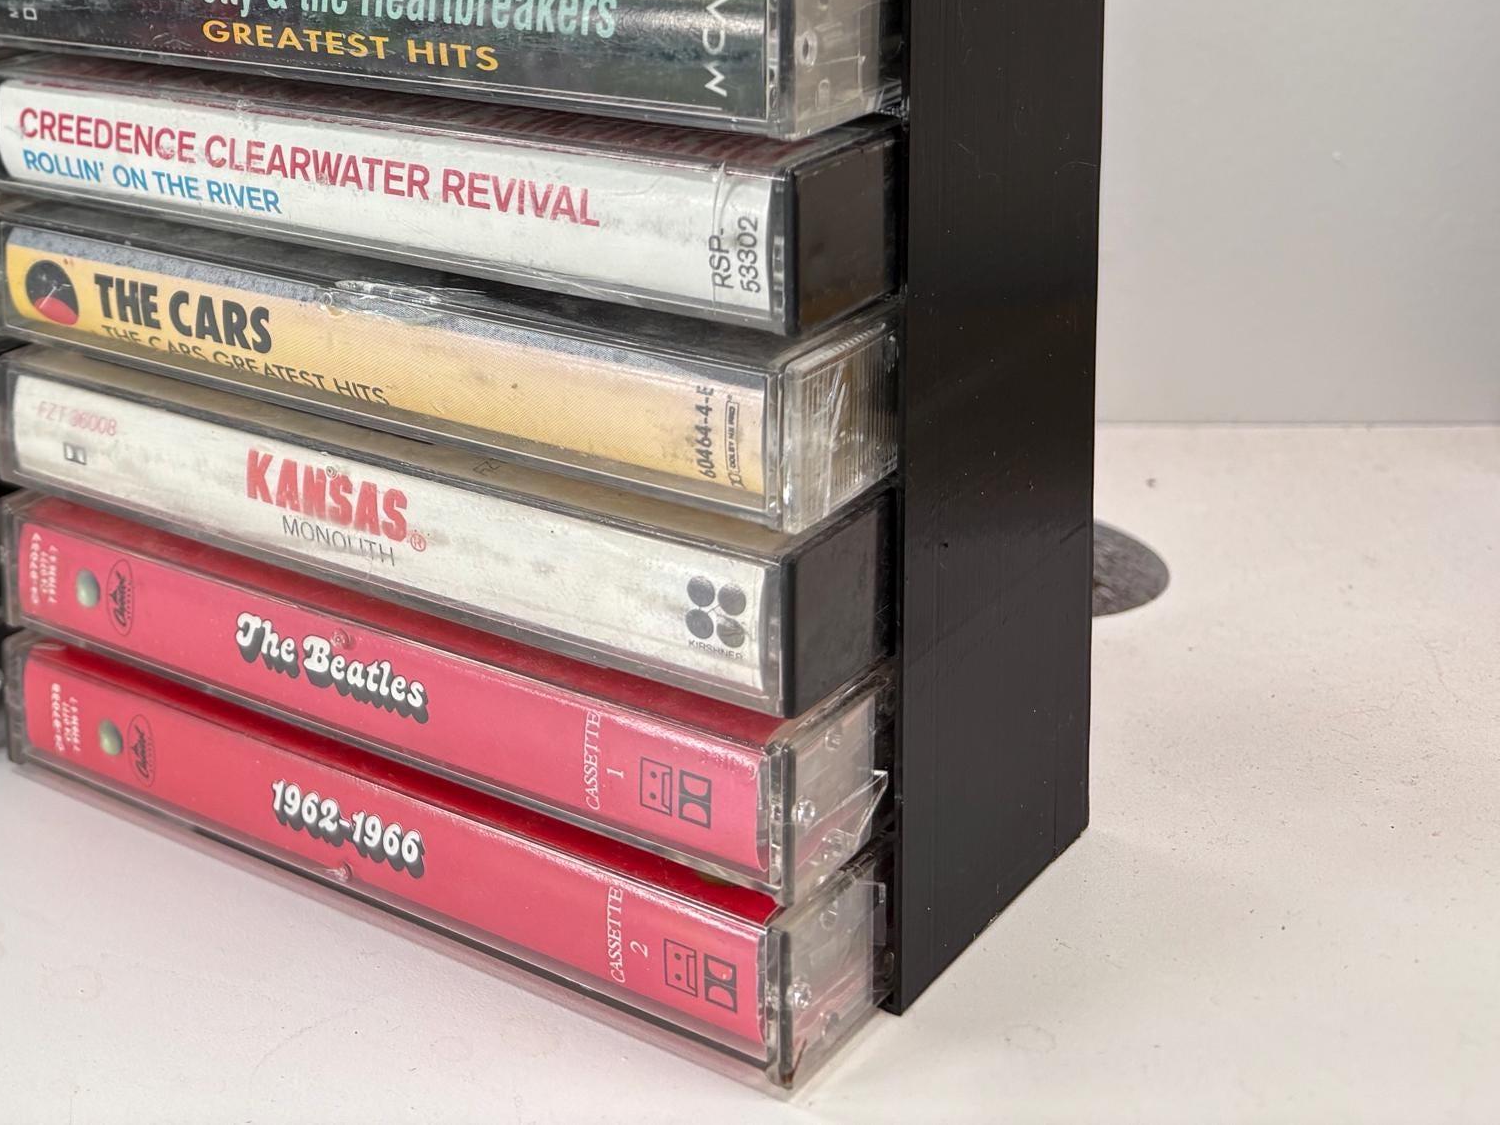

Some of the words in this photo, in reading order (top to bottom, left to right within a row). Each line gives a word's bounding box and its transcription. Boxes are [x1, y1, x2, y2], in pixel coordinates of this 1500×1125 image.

[202, 20, 388, 59] GREATEST
[408, 39, 498, 72] HITS
[20, 107, 196, 165] CREEDENCE
[204, 134, 431, 201] CLEARWATER
[442, 168, 600, 228] REVIVAL
[23, 148, 104, 184] ROLLIN'
[112, 164, 148, 192] ON
[152, 171, 199, 201] THE
[206, 179, 283, 215] RIVER
[737, 215, 760, 295] 53302
[94, 273, 162, 331] THE
[169, 290, 274, 354] CARS
[102, 324, 142, 345] THE
[148, 335, 210, 363] CARS
[213, 350, 328, 392] GREATEST
[332, 376, 390, 406] HITS
[694, 385, 717, 479] 60464-4-E
[245, 447, 408, 542] KANSAS
[282, 515, 396, 567] MONOLITH
[236, 611, 298, 671] The
[301, 633, 428, 715] Beatles
[583, 711, 602, 811] CASSETTE
[606, 767, 624, 779] 1
[271, 778, 424, 871] 1962-1966
[606, 885, 626, 985] CASSETTE
[630, 940, 649, 958] 2
